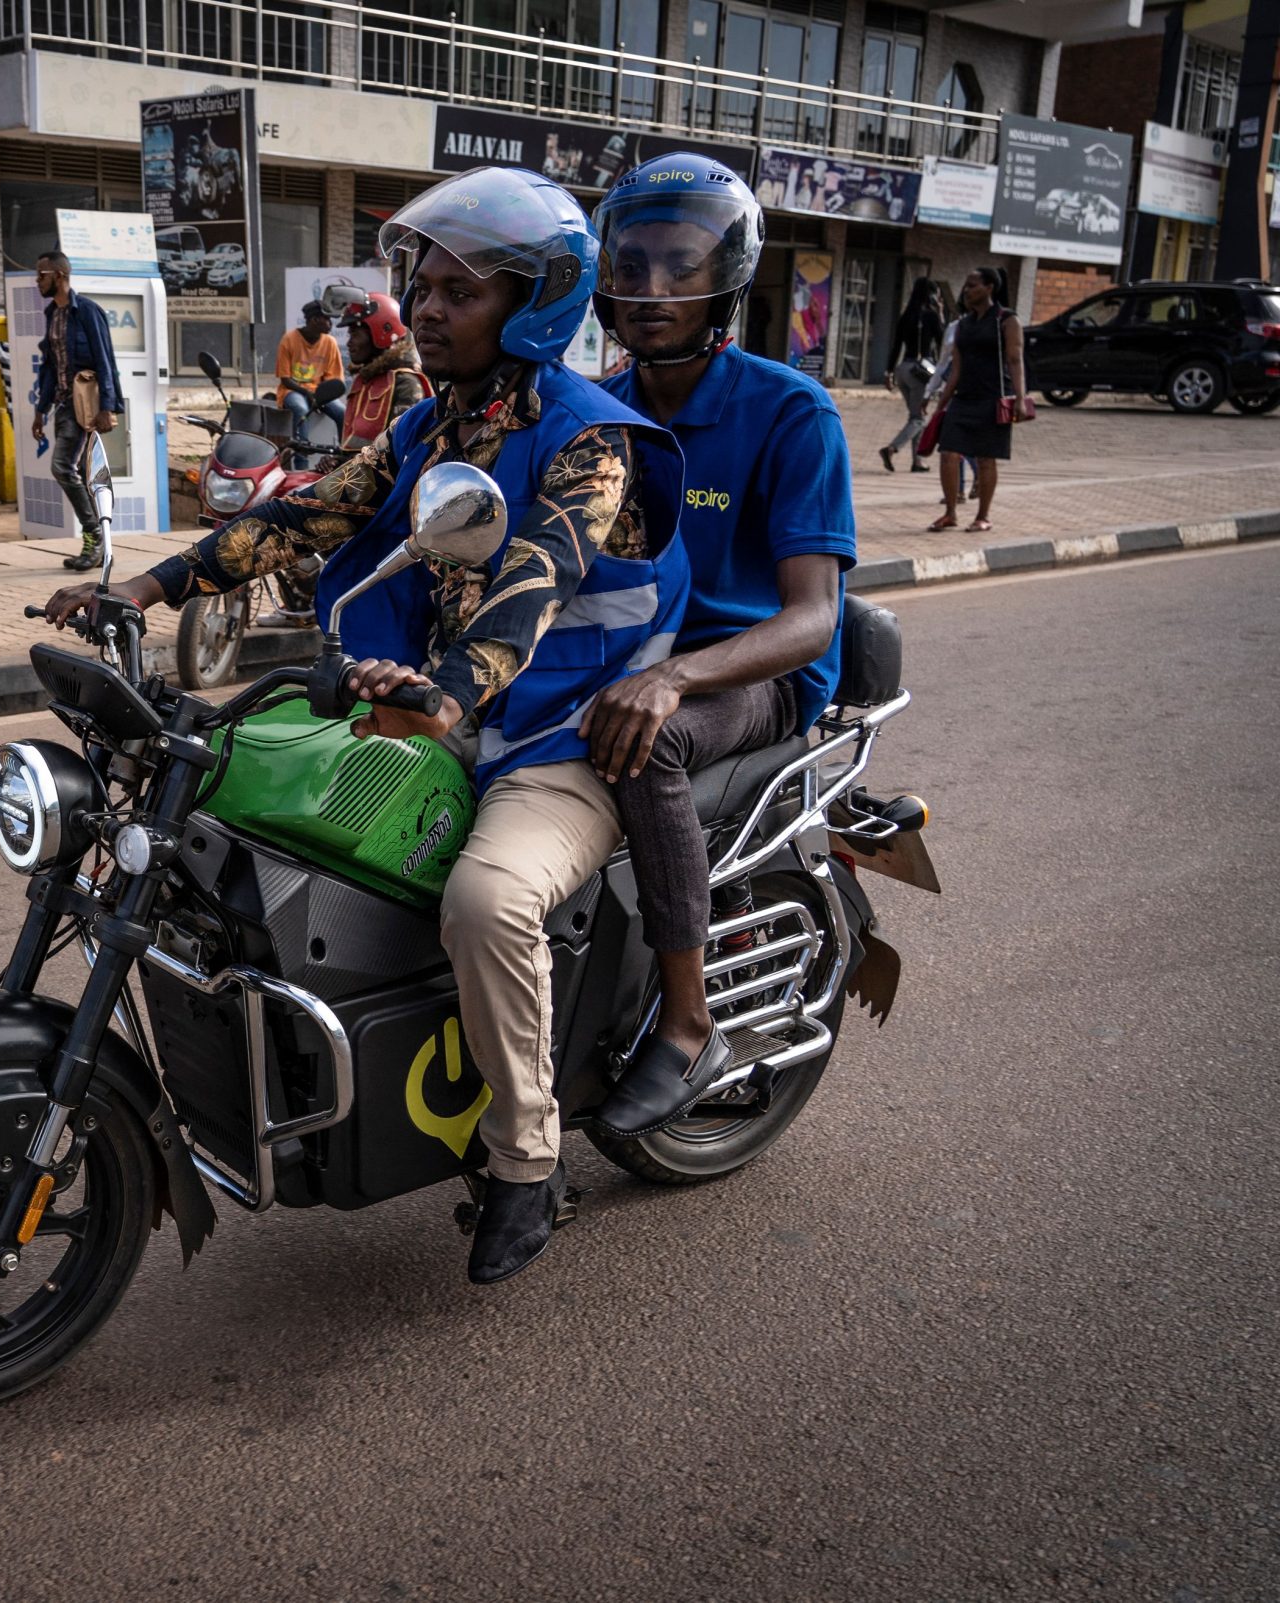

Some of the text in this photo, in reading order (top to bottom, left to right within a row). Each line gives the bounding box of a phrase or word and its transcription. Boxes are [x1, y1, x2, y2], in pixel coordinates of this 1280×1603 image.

[173, 98, 195, 115] Ndoli
[196, 96, 224, 112] Safaris
[226, 93, 240, 109] Ltd
[257, 122, 280, 139] FE
[443, 131, 524, 163] AHAVAH
[648, 169, 695, 184] spiro
[685, 487, 731, 512] spiro
[401, 812, 453, 878] COMMANDO
